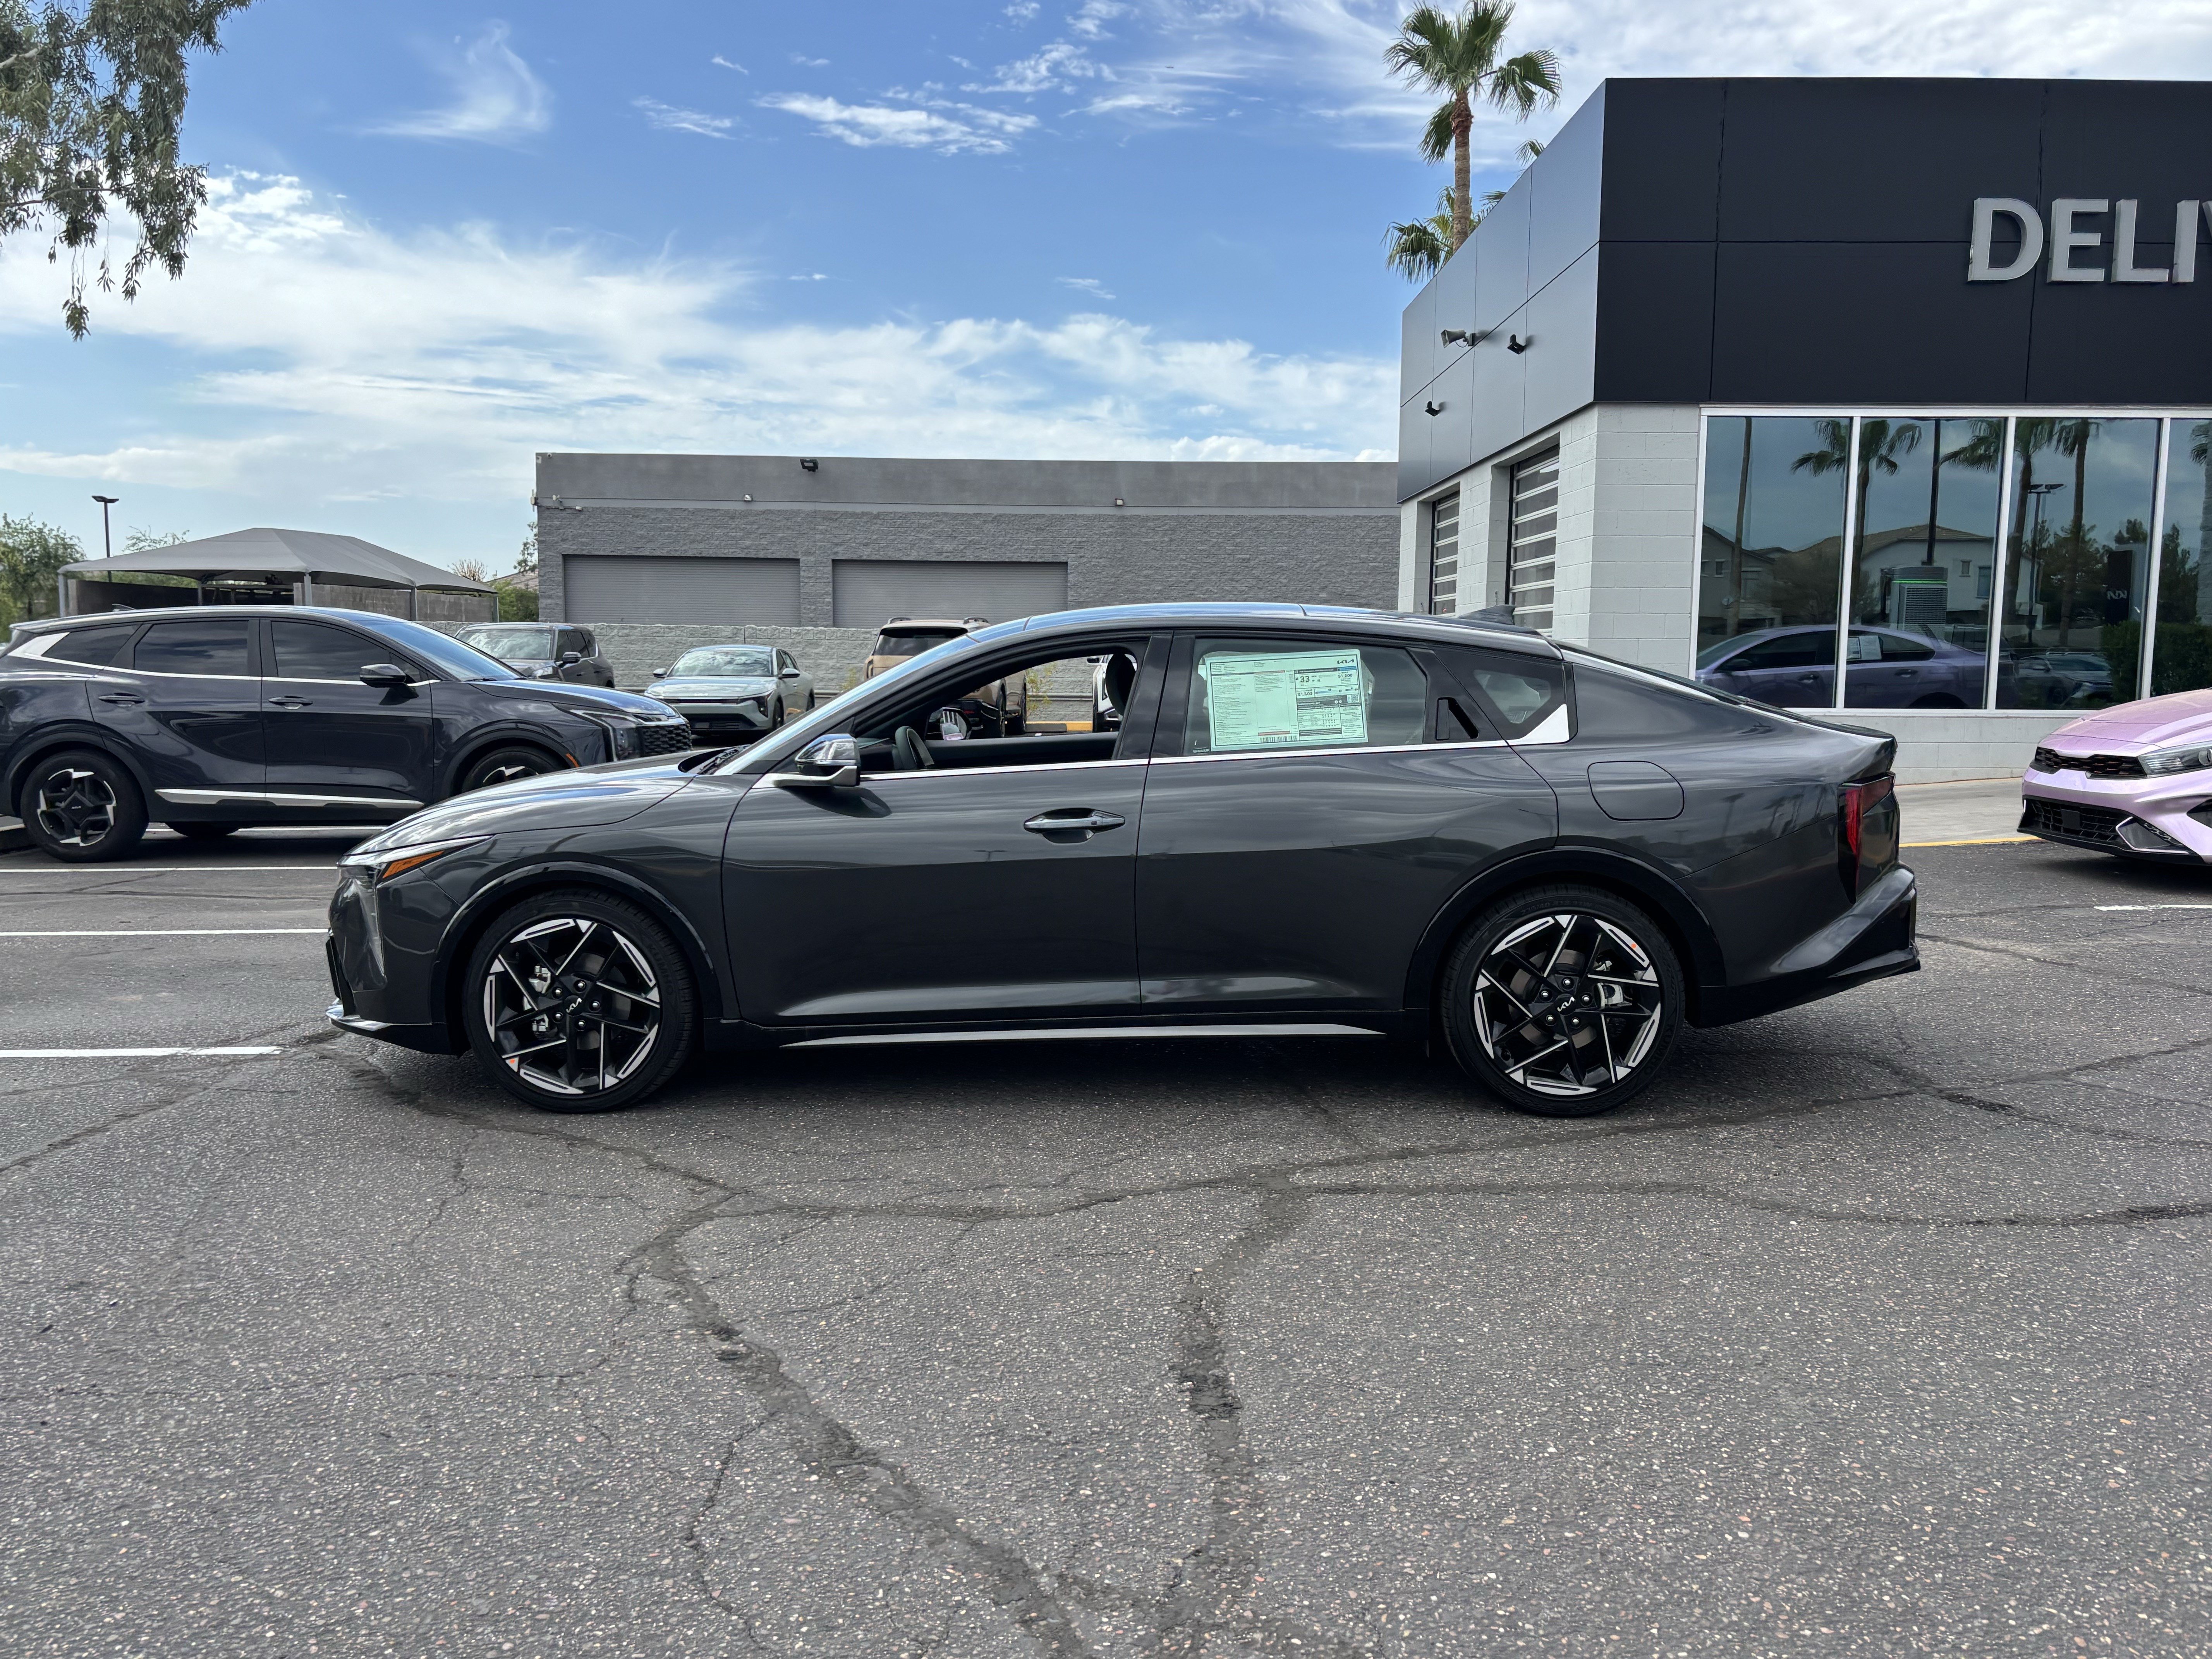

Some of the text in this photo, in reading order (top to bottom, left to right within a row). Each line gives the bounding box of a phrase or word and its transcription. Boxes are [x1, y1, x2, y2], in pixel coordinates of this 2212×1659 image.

[1968, 198, 2212, 283] DELI
[566, 998, 582, 1013] KIA
[1557, 996, 1575, 1012] KIA
